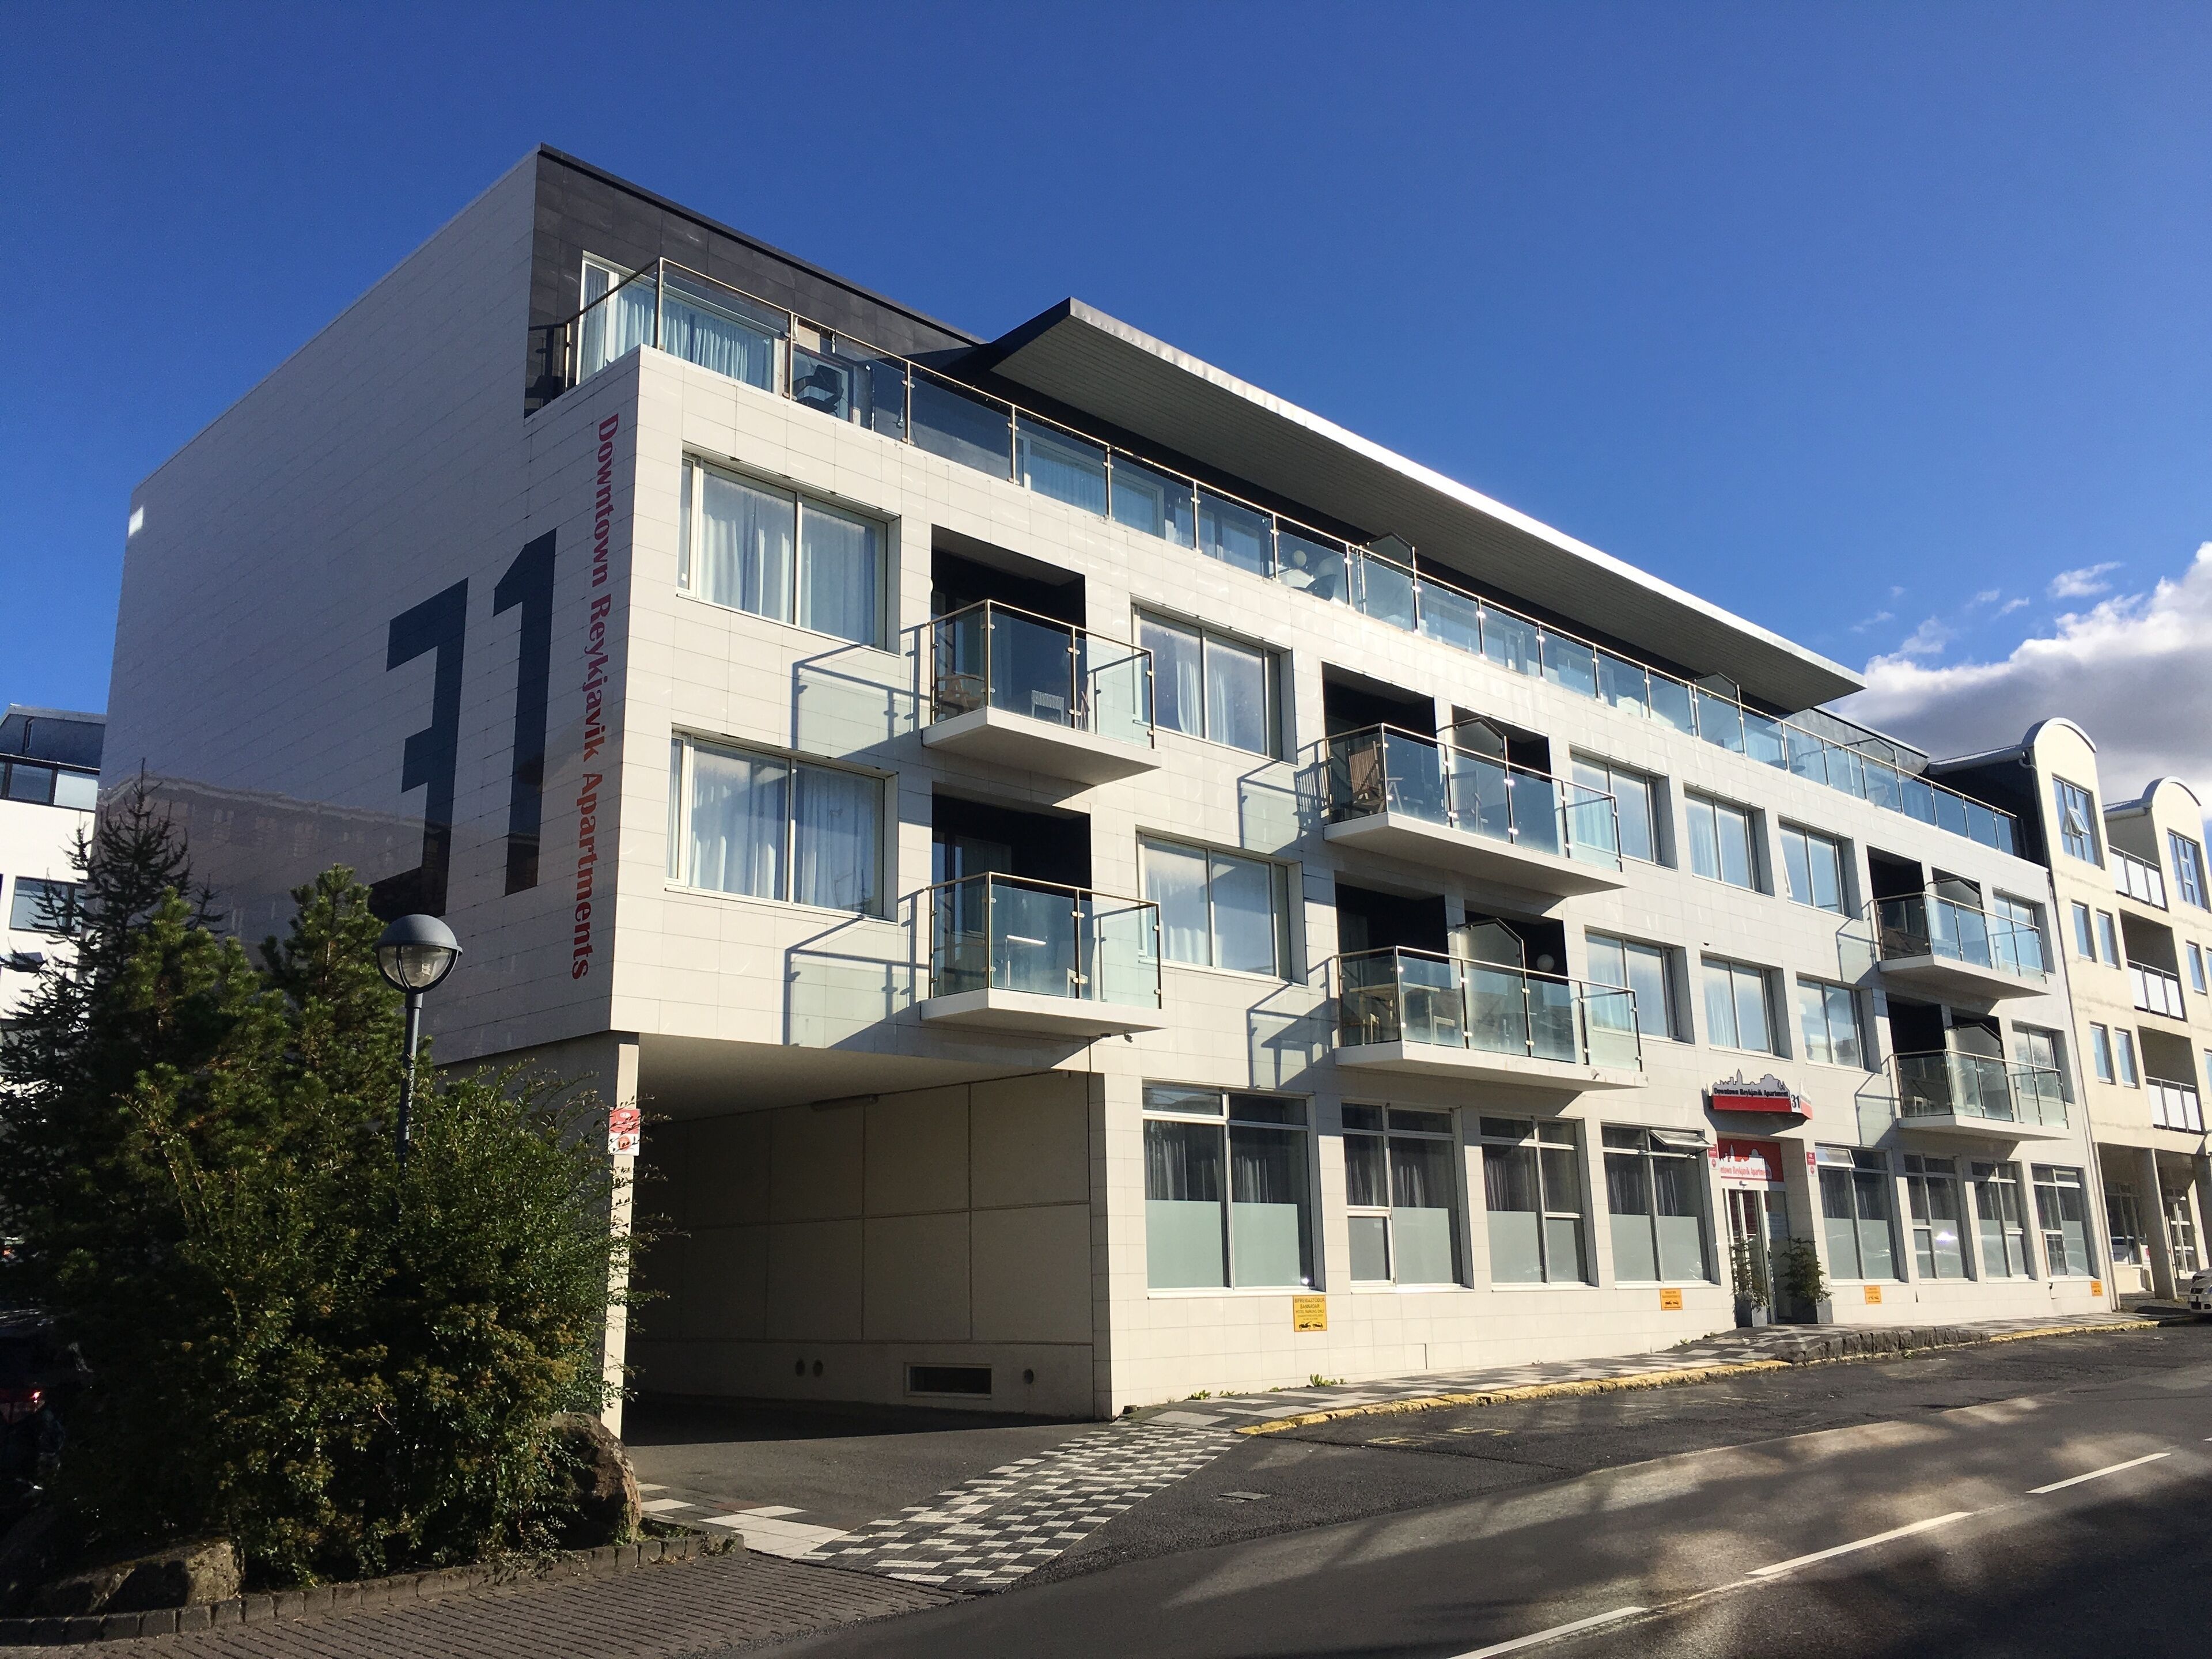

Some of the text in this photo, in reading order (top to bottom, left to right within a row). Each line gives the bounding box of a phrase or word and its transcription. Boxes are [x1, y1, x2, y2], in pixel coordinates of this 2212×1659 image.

[368, 528, 556, 923] 31
[571, 412, 619, 980] Downtown Reykjavik Apartments
[1740, 1089, 1762, 1097] Reykjavik
[1791, 1094, 1801, 1108] 31
